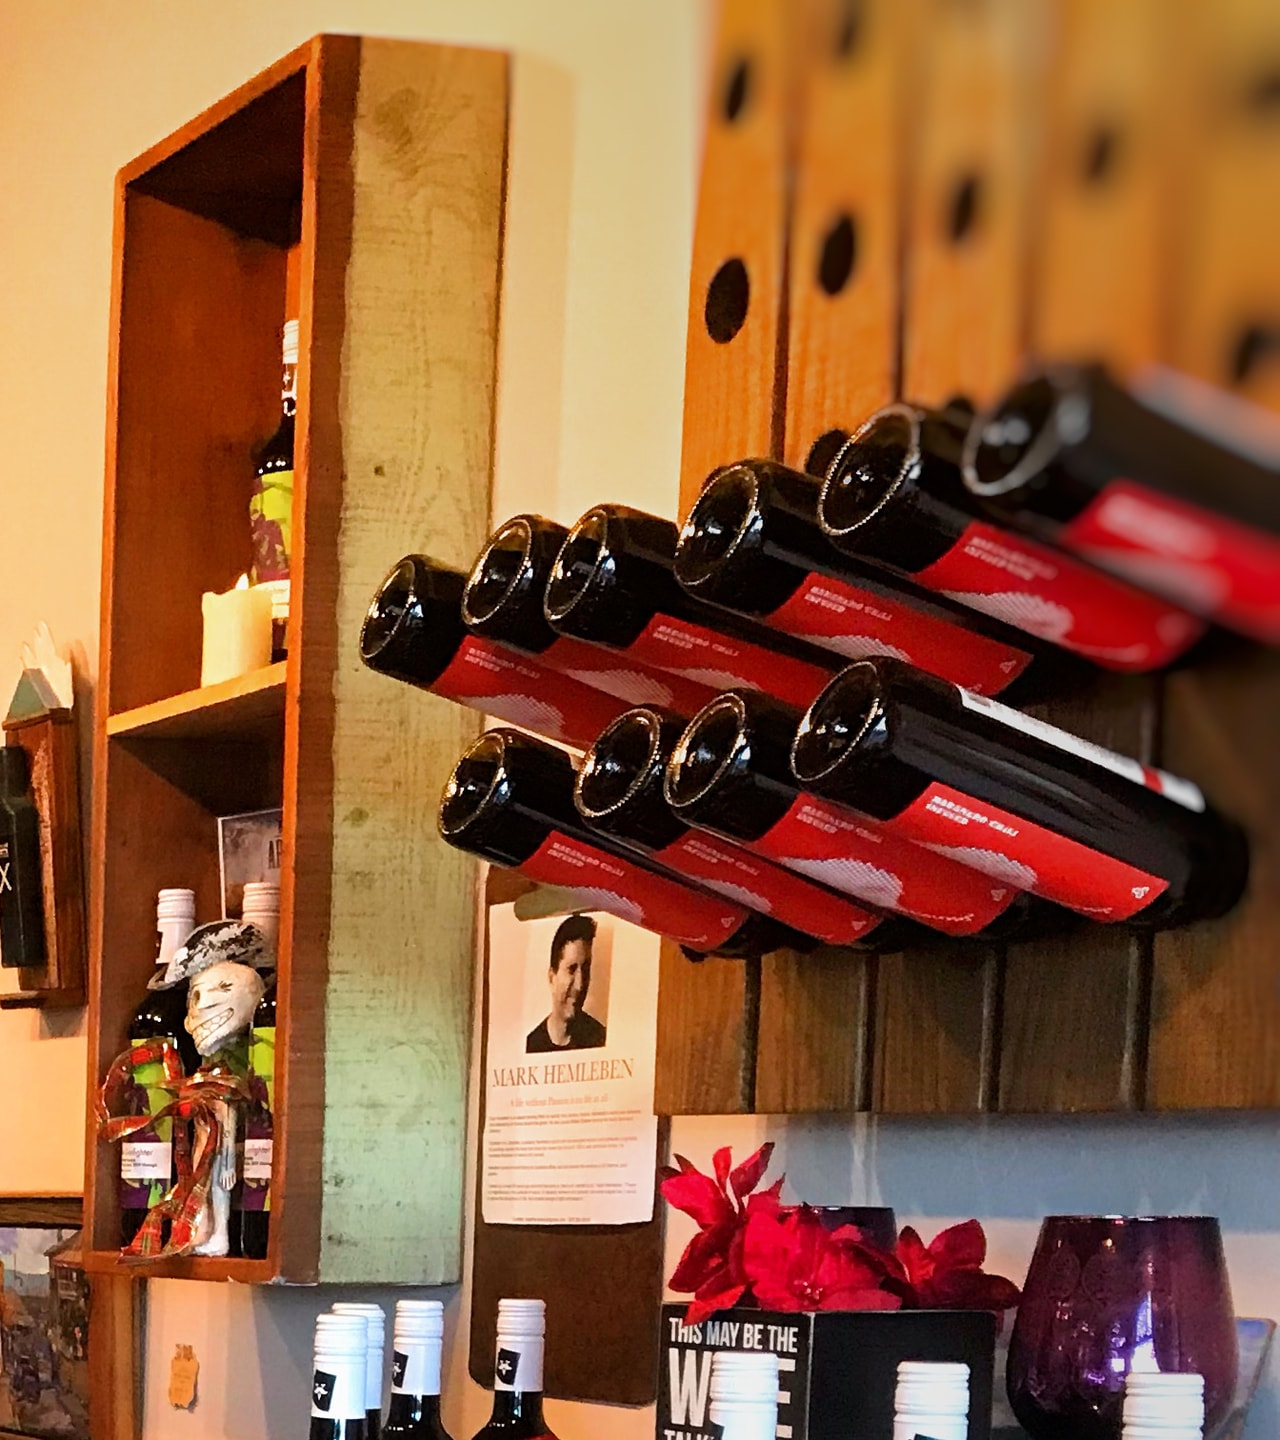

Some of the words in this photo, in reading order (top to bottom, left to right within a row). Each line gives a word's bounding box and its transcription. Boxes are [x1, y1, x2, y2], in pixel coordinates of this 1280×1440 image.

[492, 1066, 539, 1087] MARK
[543, 1058, 634, 1084] HEMLEBEN
[669, 1317, 702, 1344] THIS
[706, 1321, 740, 1348] MAY
[743, 1324, 763, 1350] BE
[768, 1326, 799, 1352] THE
